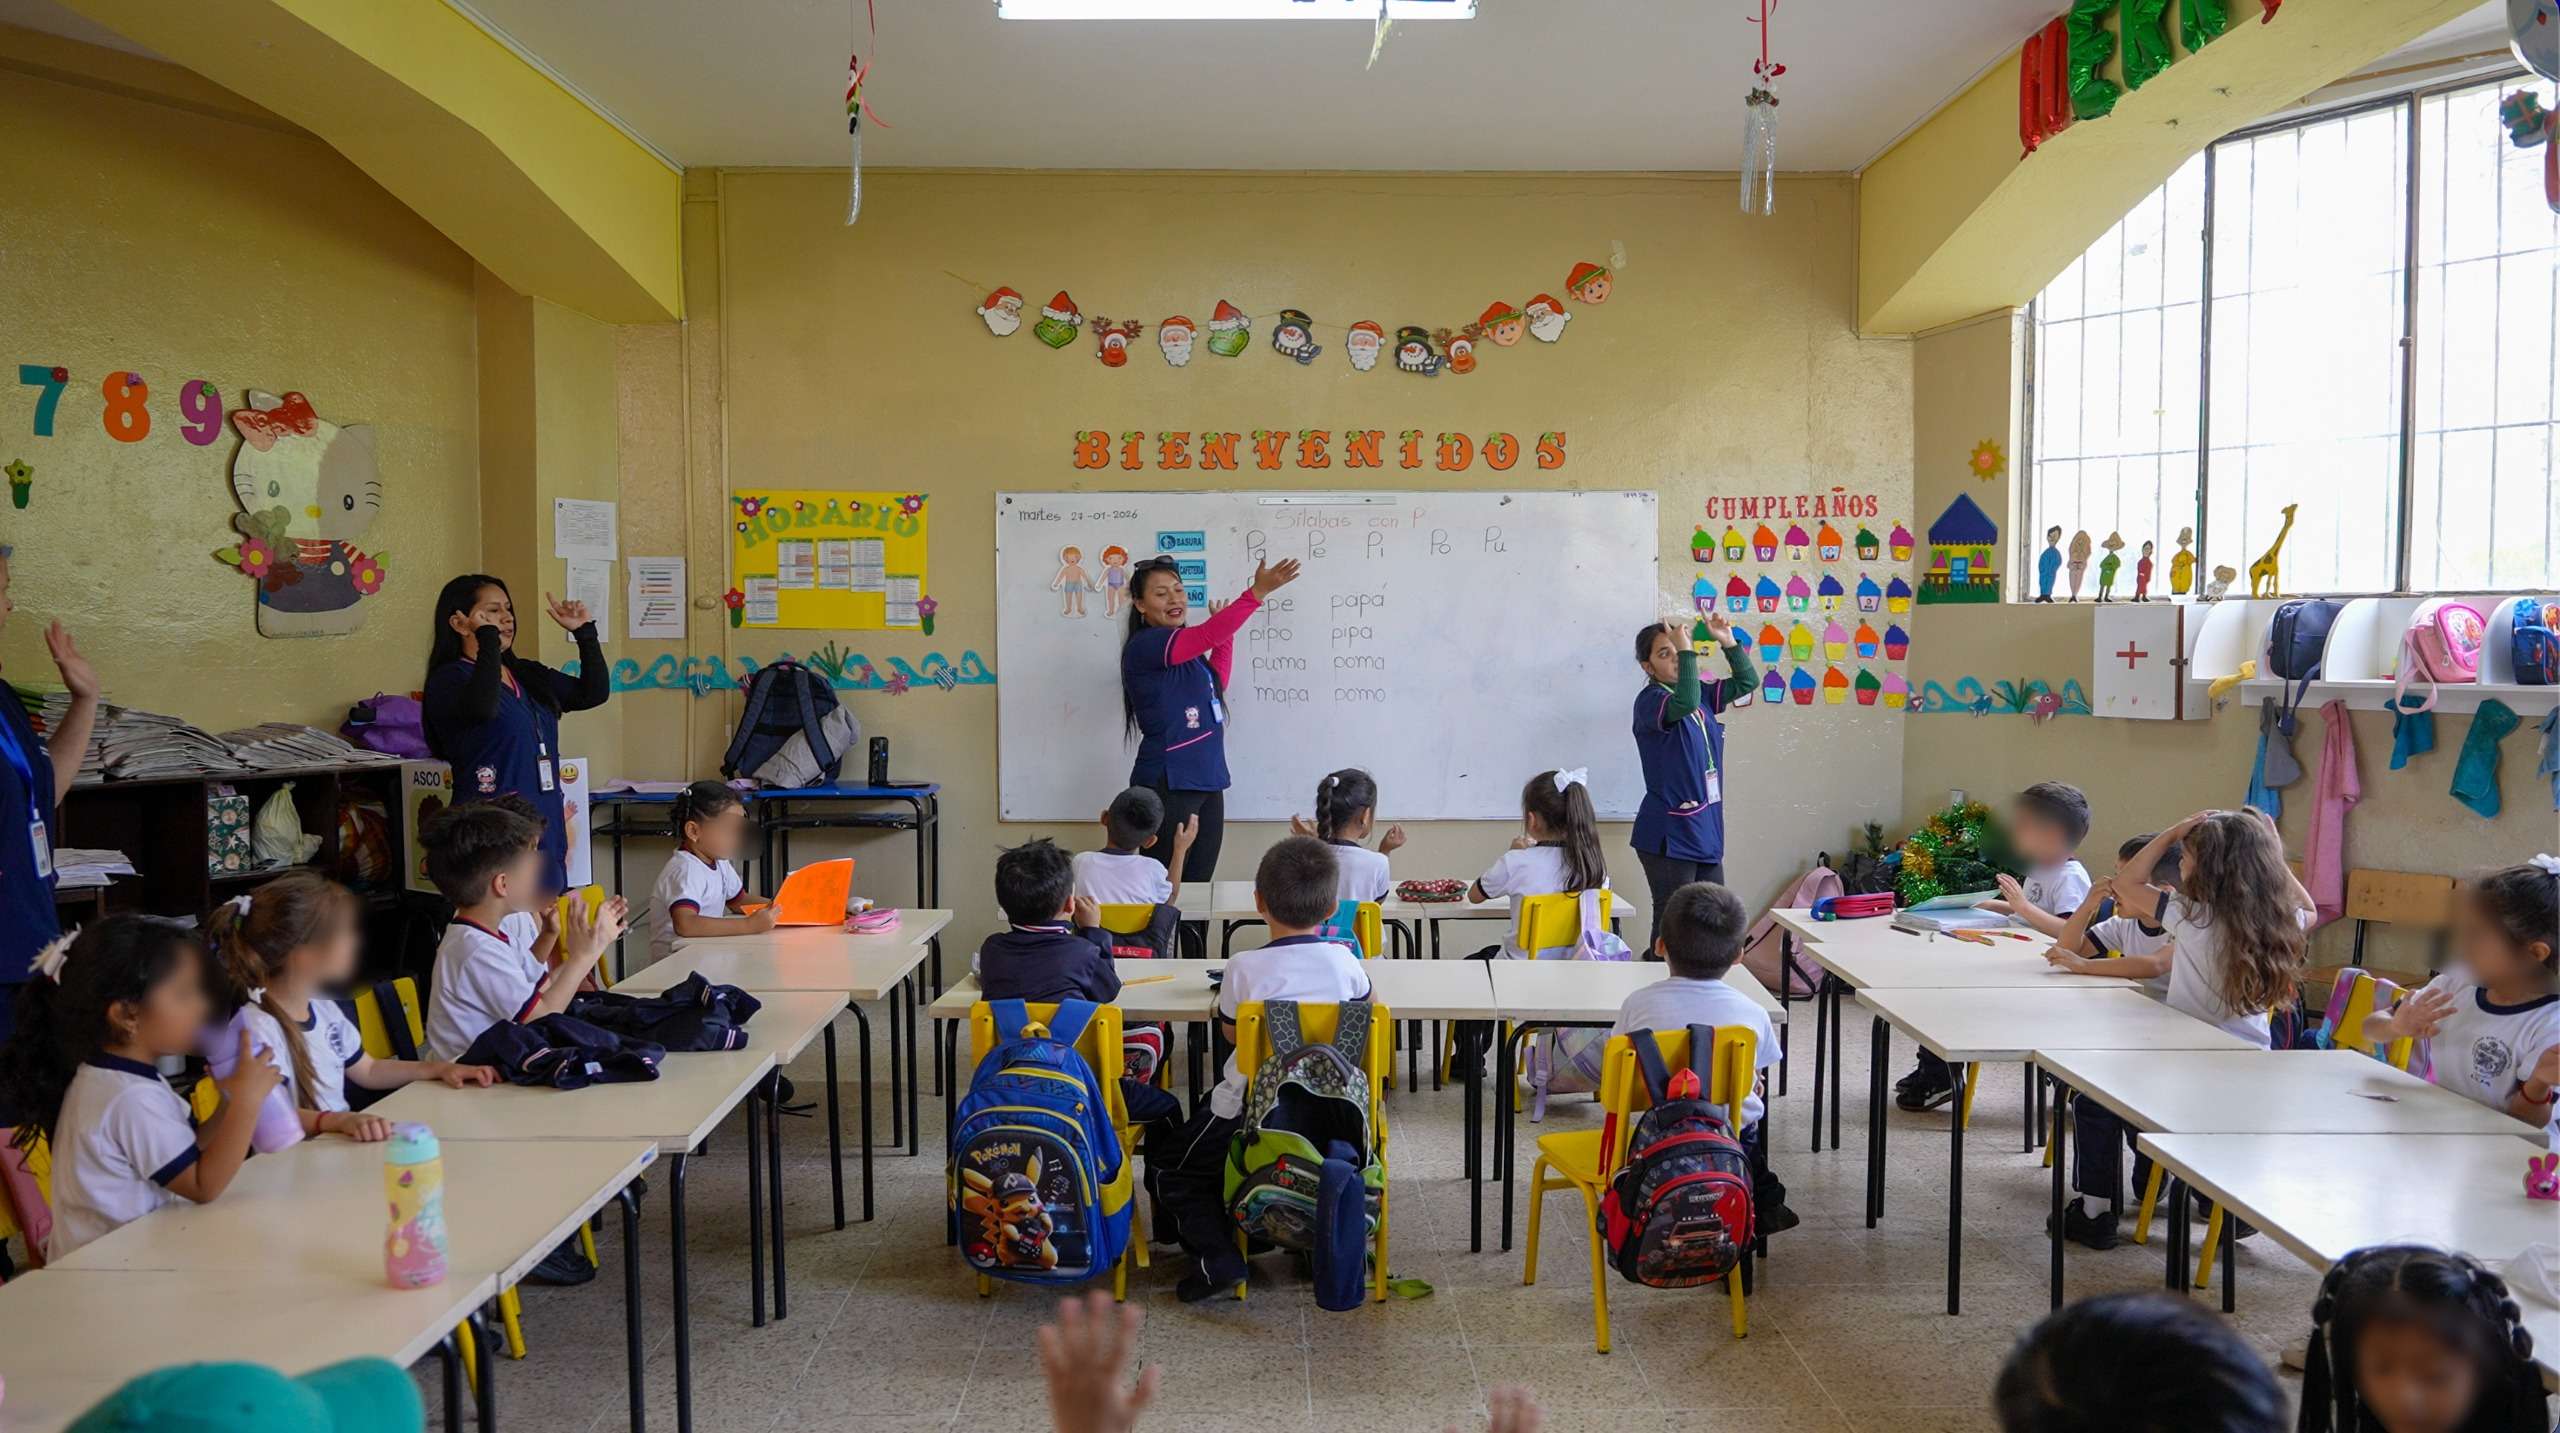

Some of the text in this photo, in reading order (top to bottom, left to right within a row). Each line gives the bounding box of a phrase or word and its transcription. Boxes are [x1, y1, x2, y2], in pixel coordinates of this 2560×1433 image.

[19, 364, 223, 446] 7 8 9
[1073, 430, 1567, 470] BIENVENIDOS
[1368, 514, 1399, 529] con
[1412, 507, 1426, 528] P
[1706, 486, 1879, 520] CUMPLEAÑOS
[740, 500, 919, 548] HORARIO
[1246, 525, 1507, 562] Pa Pe Pi Po Pu
[1187, 589, 1204, 602] AÑO
[1331, 582, 1386, 622] papá
[1331, 626, 1373, 648] pipa
[1252, 656, 1307, 683] puma
[413, 771, 440, 786] ASCO
